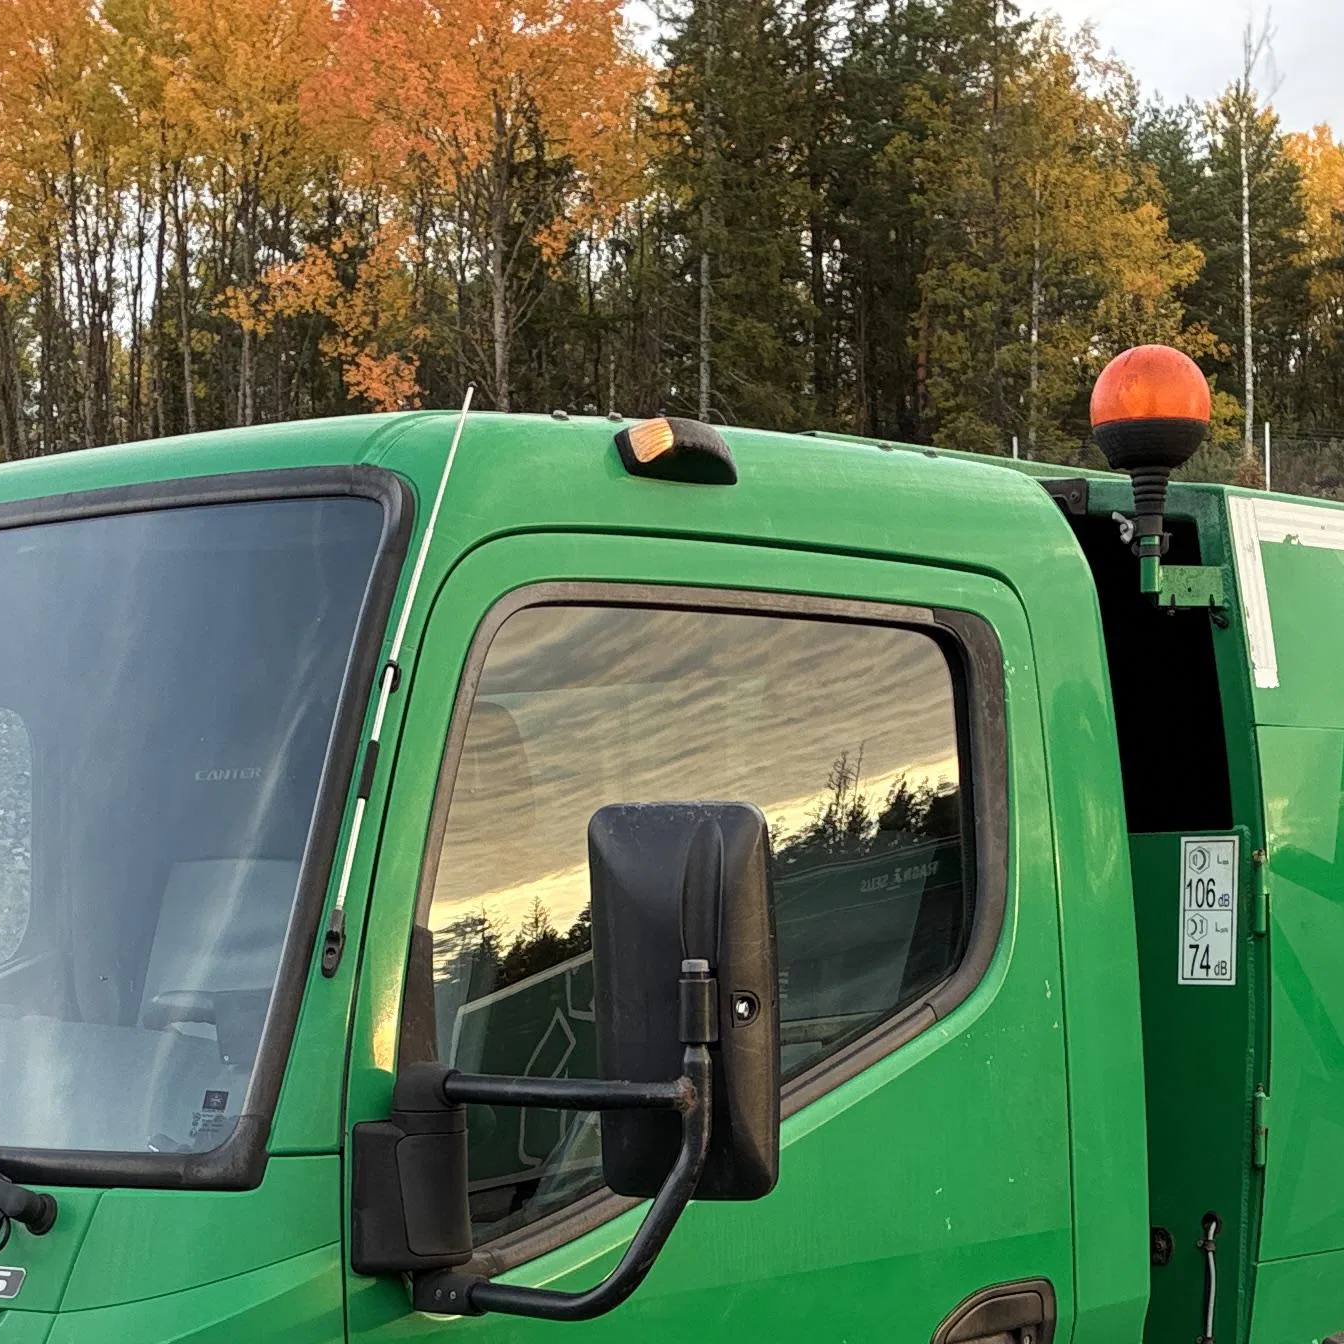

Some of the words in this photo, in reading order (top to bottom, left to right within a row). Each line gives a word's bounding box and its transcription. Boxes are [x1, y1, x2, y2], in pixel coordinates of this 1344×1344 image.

[195, 768, 261, 781] CANTER
[1186, 878, 1216, 908] 106
[1218, 893, 1230, 908] dB
[1189, 944, 1211, 977] 74
[1214, 960, 1228, 976] dB
